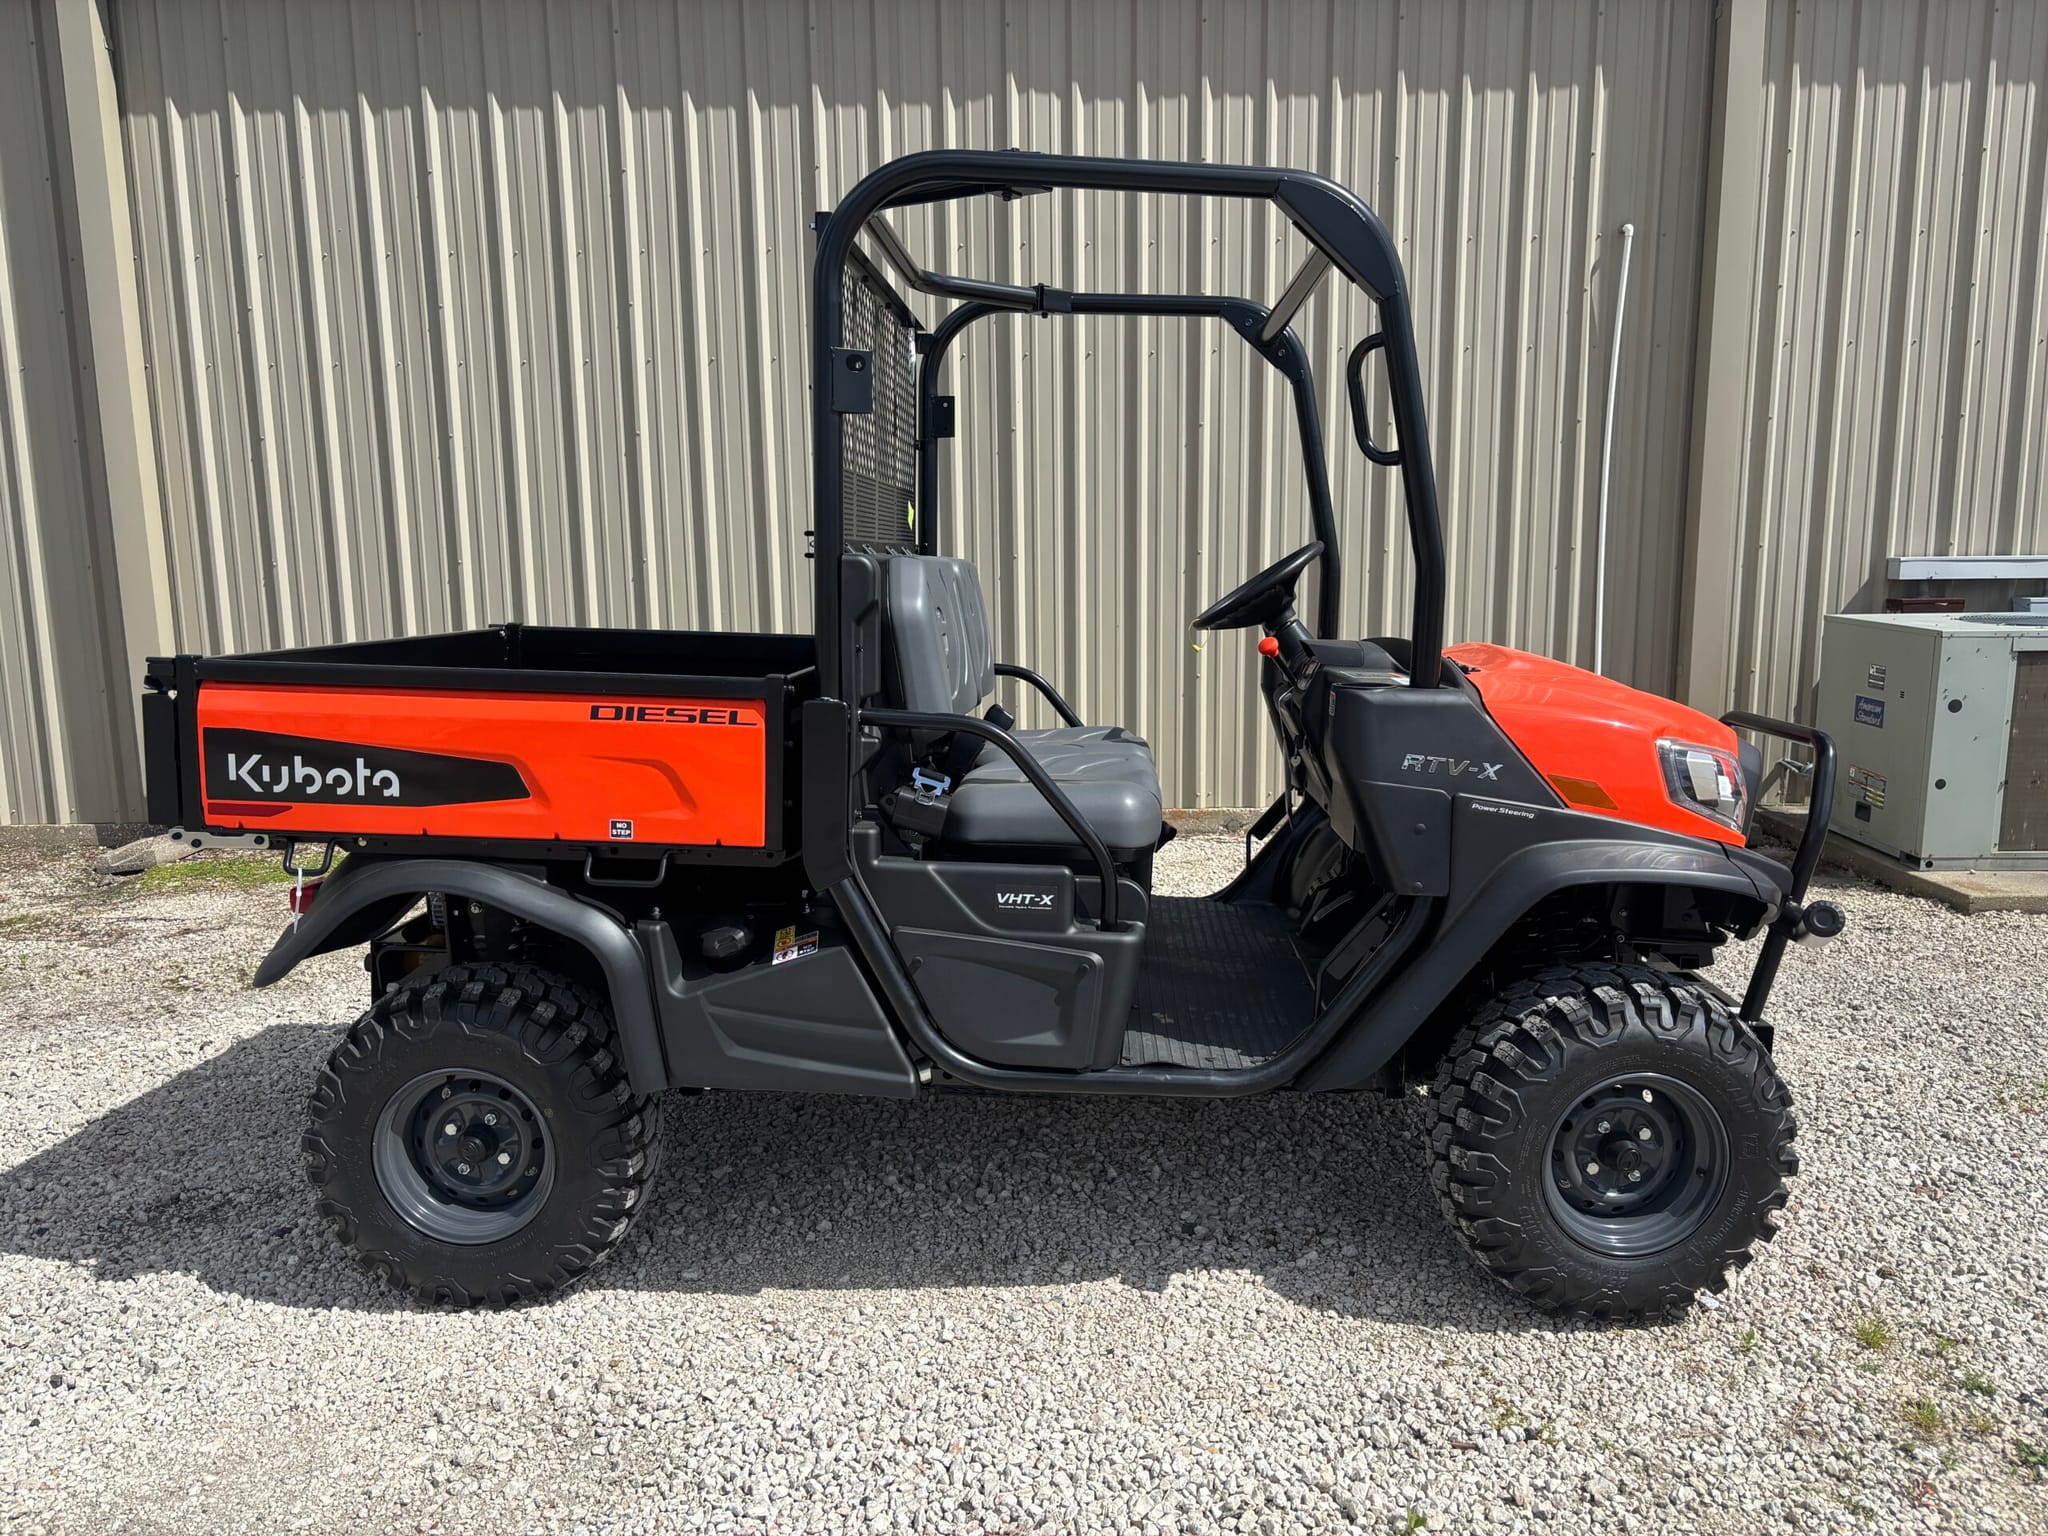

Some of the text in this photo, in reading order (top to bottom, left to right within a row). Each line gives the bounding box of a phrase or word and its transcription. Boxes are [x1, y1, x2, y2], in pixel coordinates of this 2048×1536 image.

[590, 705, 757, 726] DIESEL
[227, 753, 400, 798] Kubota
[1401, 753, 1503, 780] RTV-X
[1471, 803, 1535, 819] Power Steering
[997, 893, 1055, 905] VHT-X
